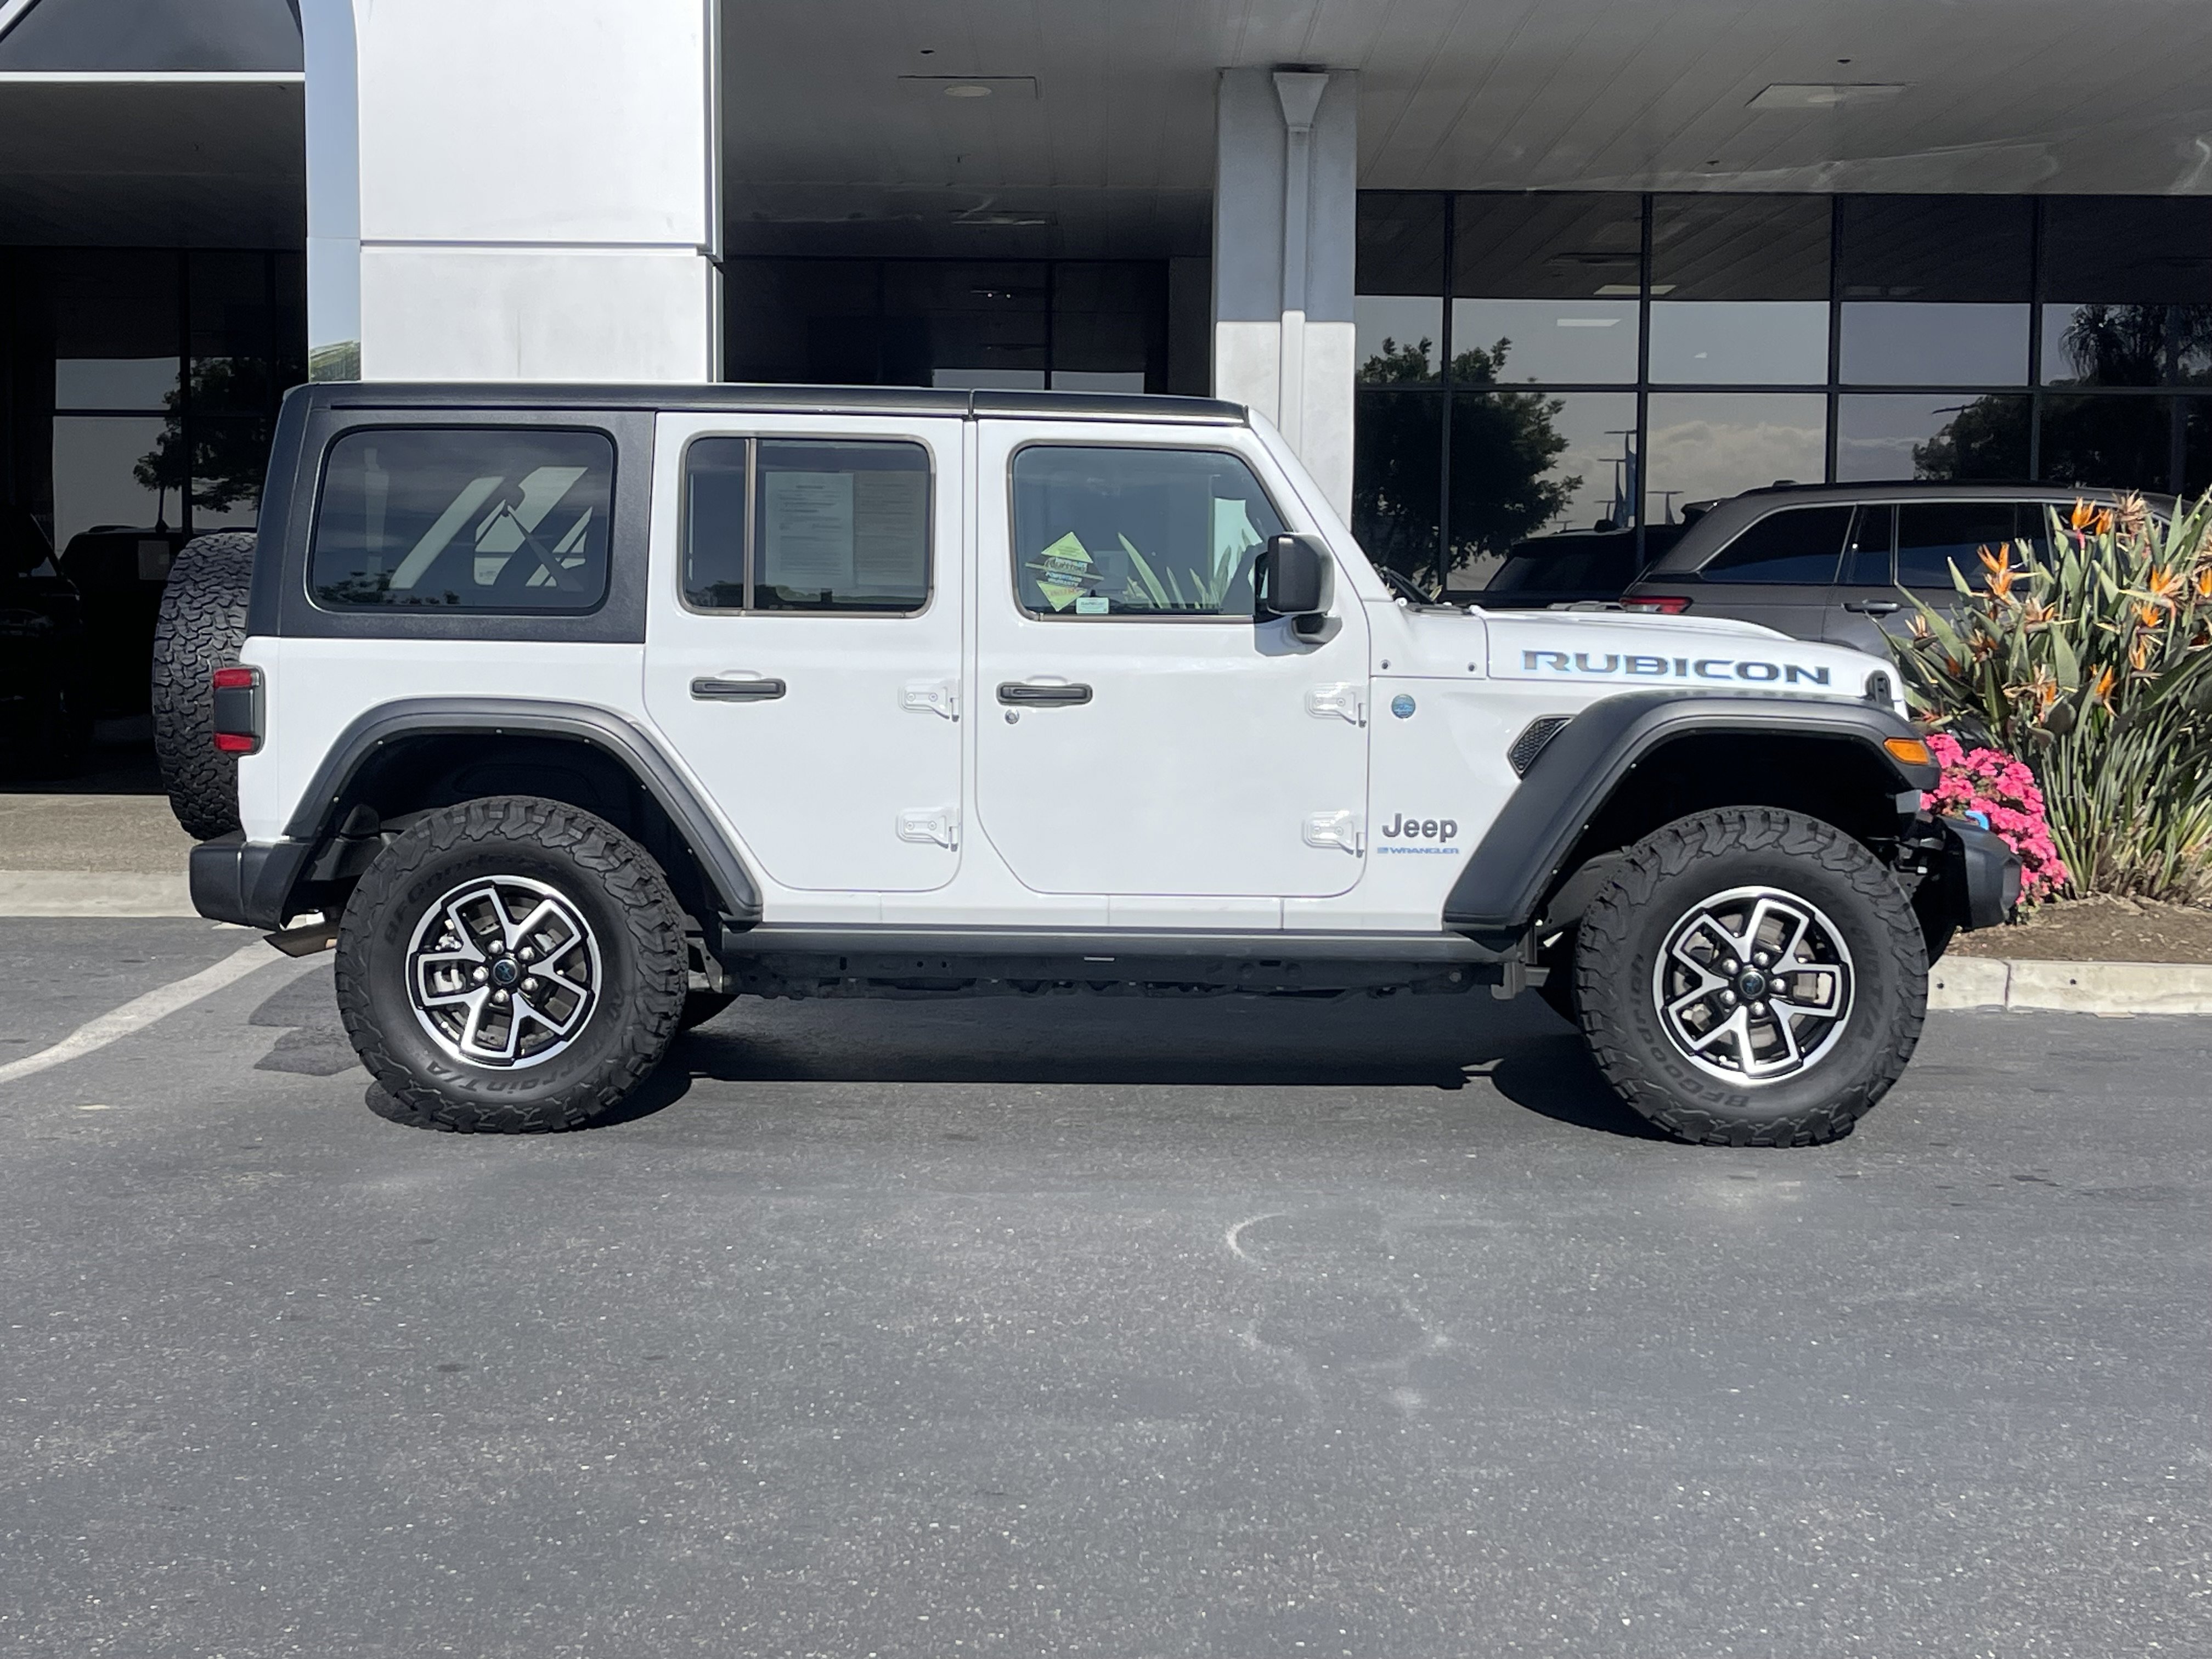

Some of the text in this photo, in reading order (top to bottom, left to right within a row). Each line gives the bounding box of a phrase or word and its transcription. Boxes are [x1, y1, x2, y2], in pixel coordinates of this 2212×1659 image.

[1522, 650, 1830, 686] RUBICON
[1382, 812, 1457, 843] Jeep
[1628, 951, 1748, 1108] BFGoodrich
[425, 1058, 479, 1093] T/A
